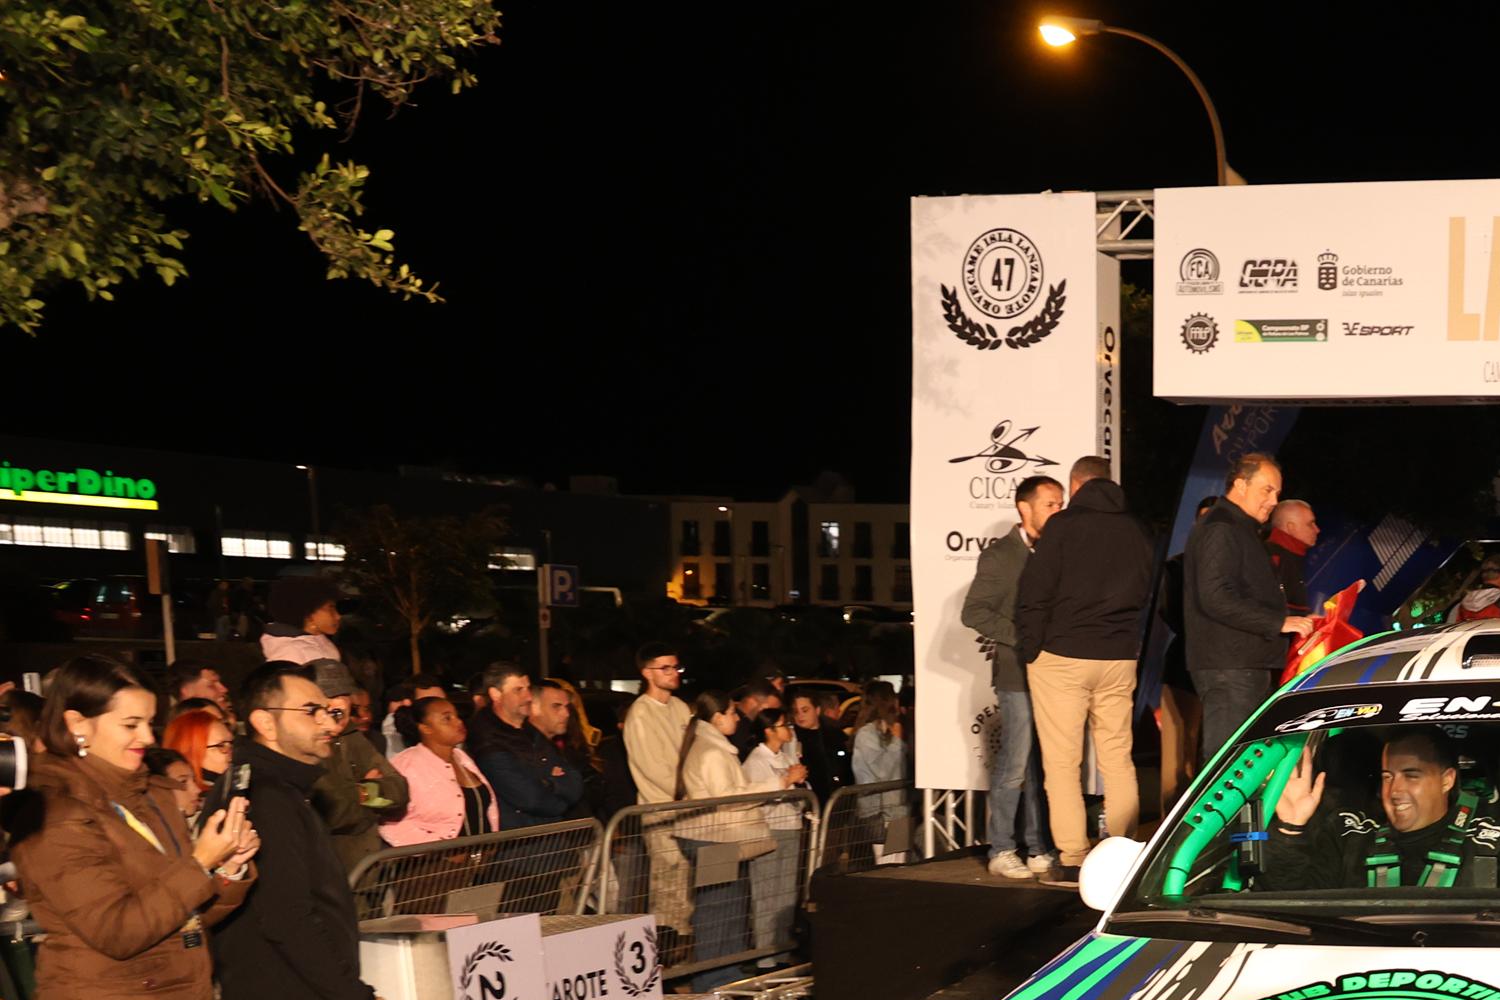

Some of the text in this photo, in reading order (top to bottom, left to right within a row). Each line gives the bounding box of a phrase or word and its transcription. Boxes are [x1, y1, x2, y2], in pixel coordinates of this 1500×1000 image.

[984, 232, 1015, 247] ISLA
[991, 257, 1015, 292] 47
[1342, 265, 1393, 277] Gobierno
[1342, 276, 1404, 287] de Canarias
[969, 476, 1025, 499] CICA
[629, 940, 646, 974] 3
